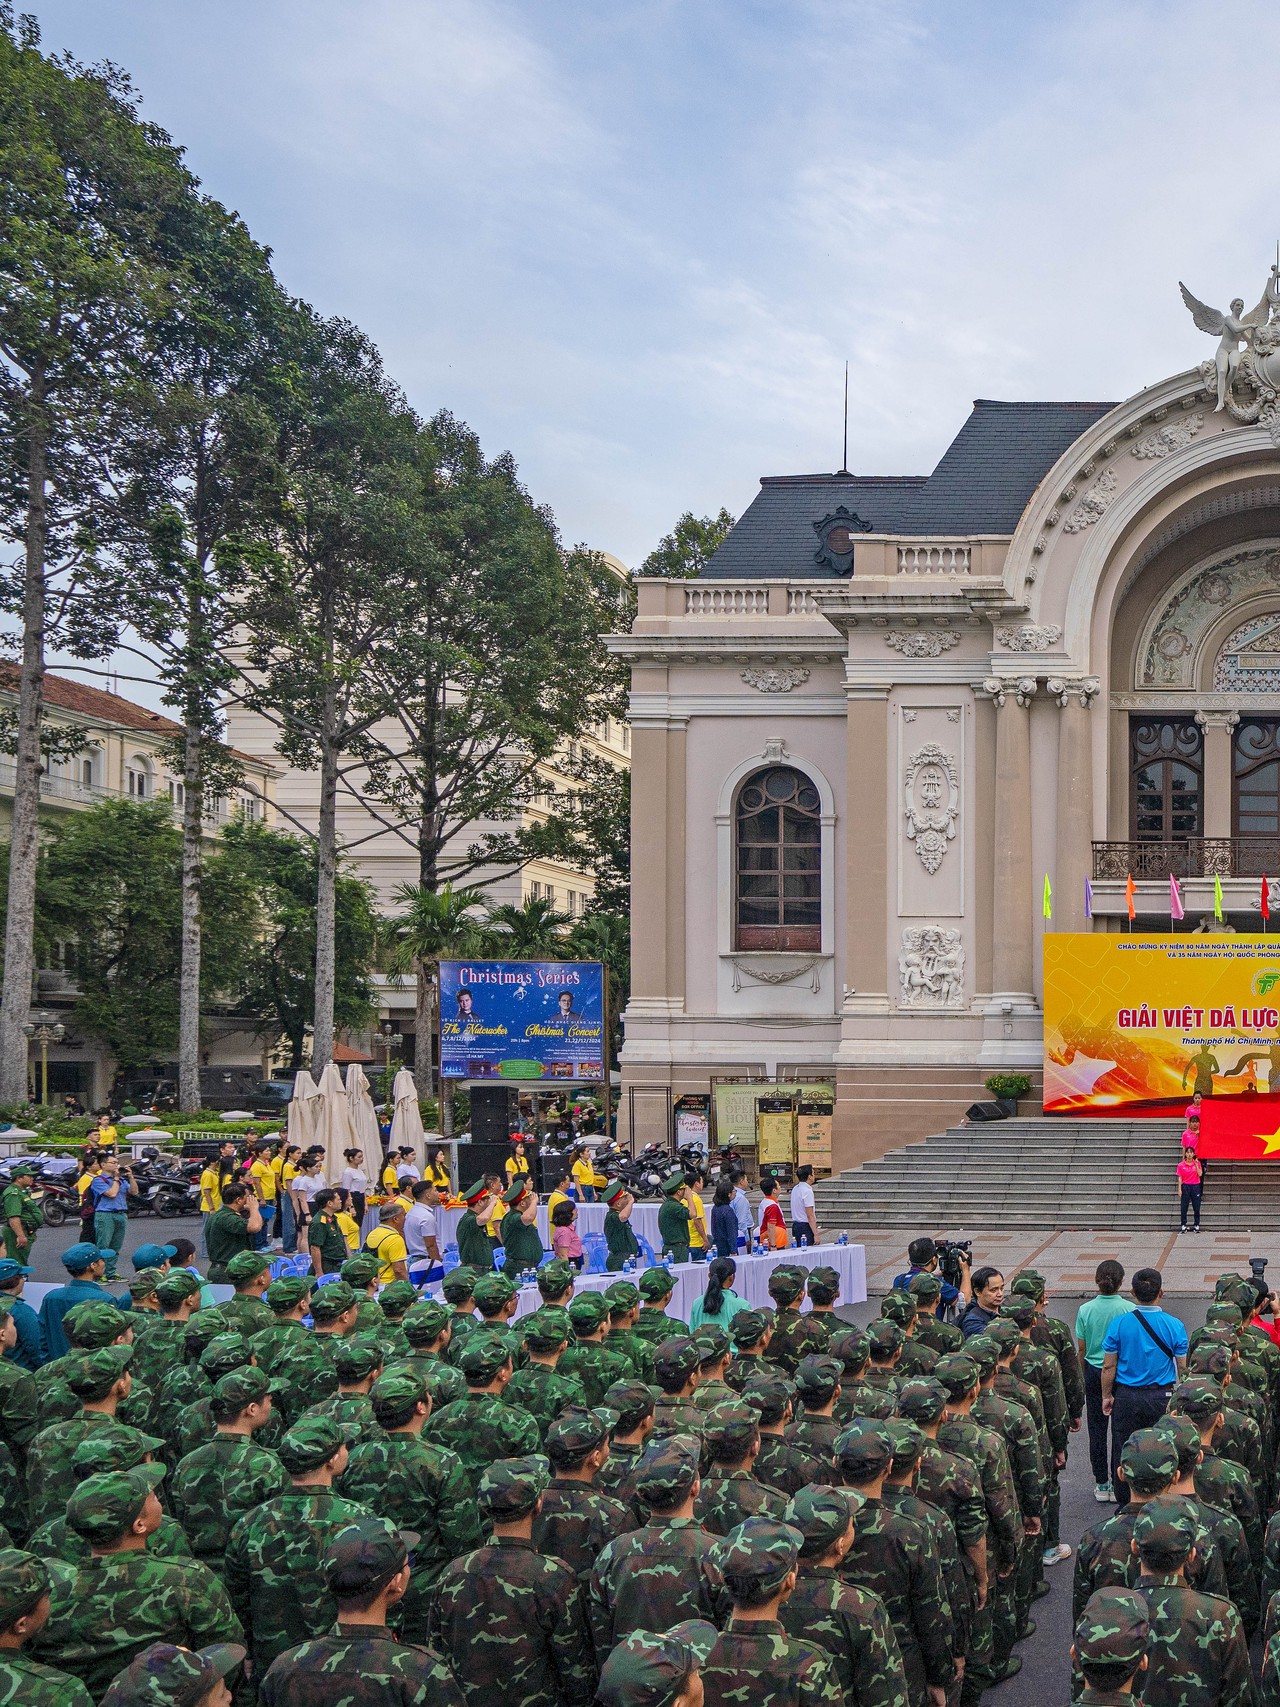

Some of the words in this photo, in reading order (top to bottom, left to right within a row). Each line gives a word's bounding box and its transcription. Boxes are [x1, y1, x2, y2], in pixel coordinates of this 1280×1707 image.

[458, 968, 532, 986] Christmas
[538, 968, 580, 987] Series
[1118, 1004, 1156, 1028] GIẢI
[1163, 1006, 1204, 1032] VIỆT
[1210, 1006, 1236, 1028] DÃ
[1242, 1008, 1278, 1032] LỰC
[442, 1023, 460, 1034] The
[463, 1023, 508, 1034] Nutcracker
[525, 1024, 564, 1037] Christmas
[568, 1024, 600, 1037] Concert
[1207, 1037, 1223, 1046] phố
